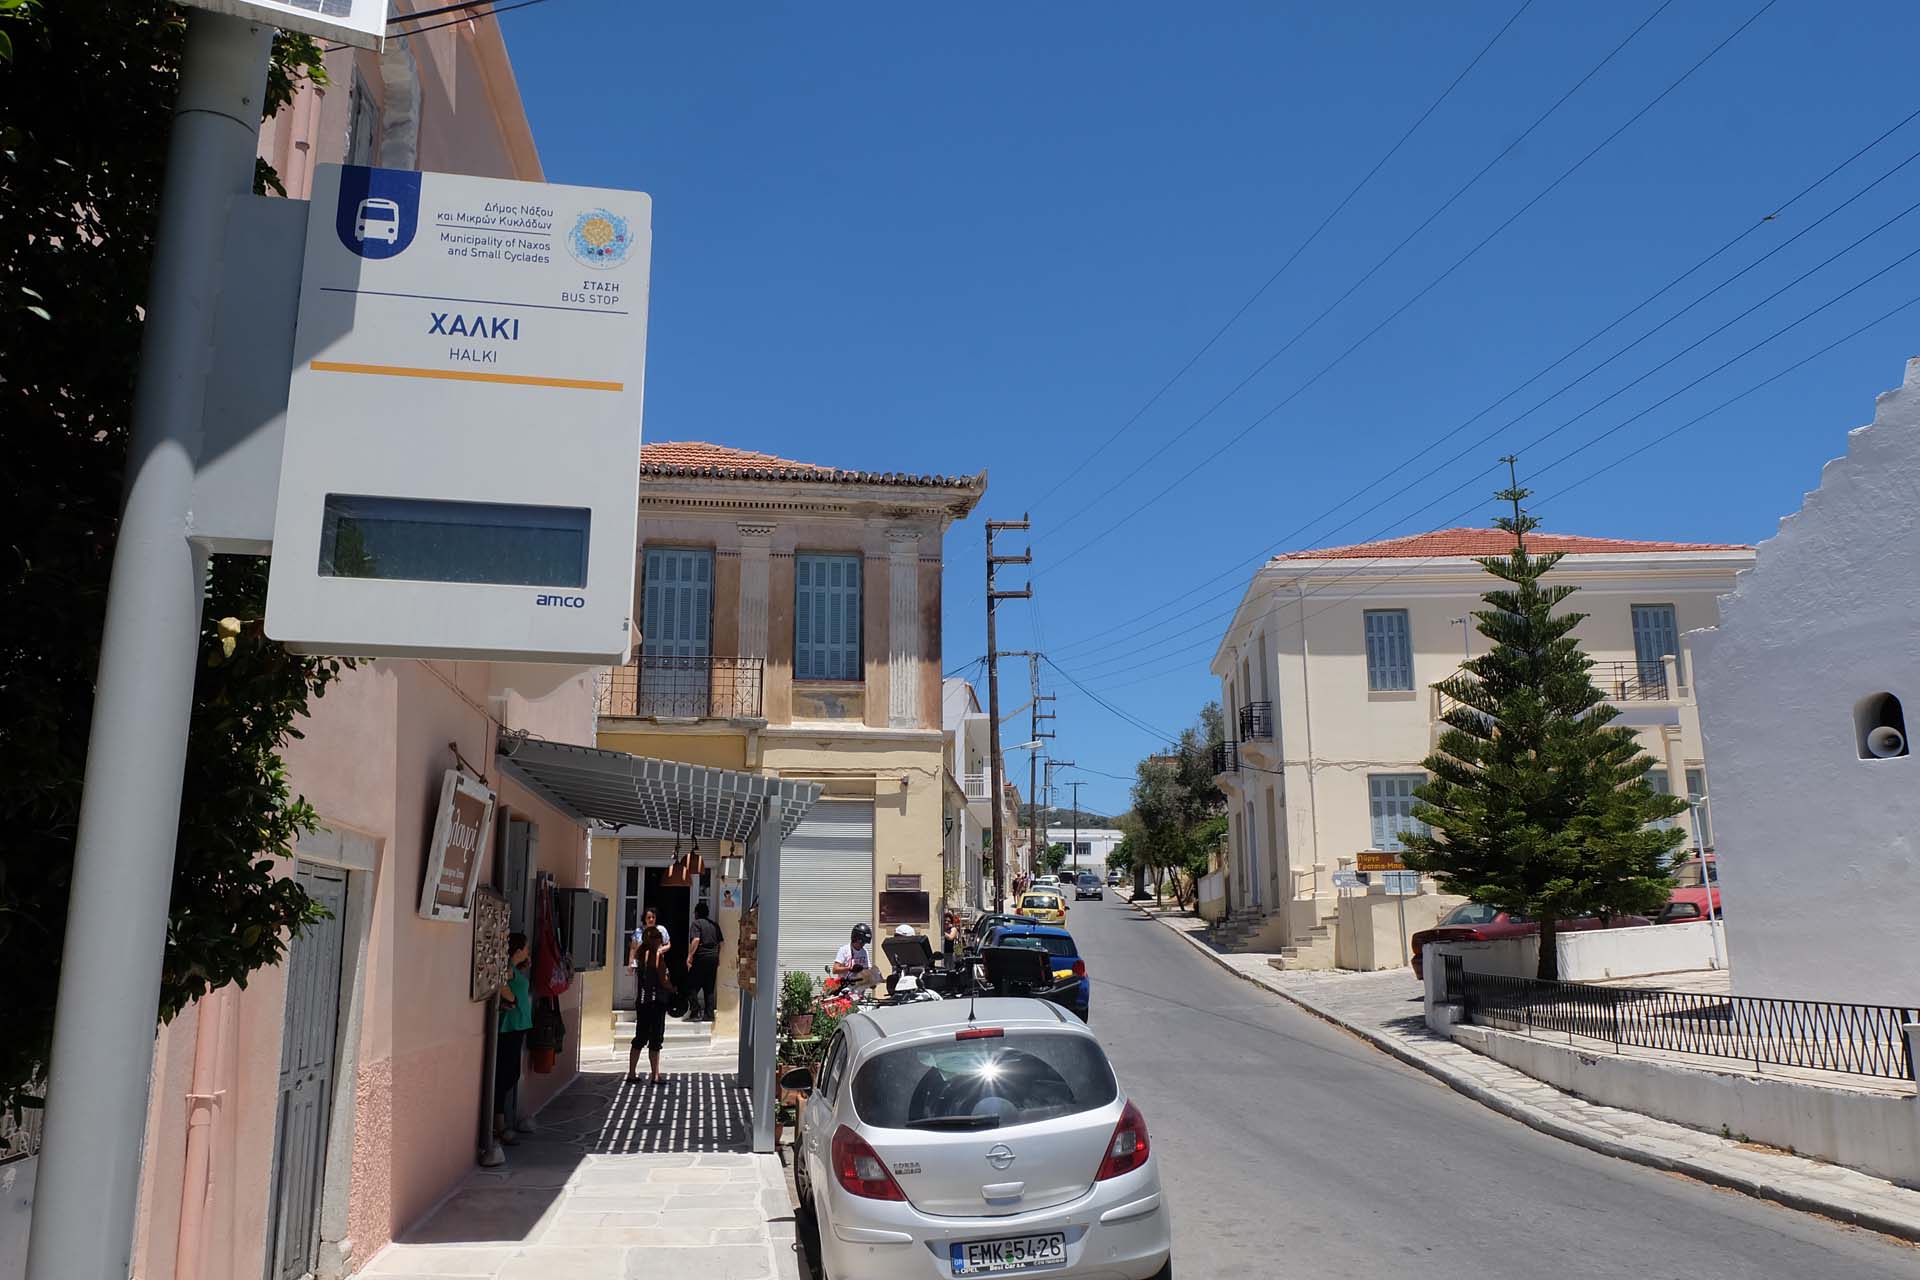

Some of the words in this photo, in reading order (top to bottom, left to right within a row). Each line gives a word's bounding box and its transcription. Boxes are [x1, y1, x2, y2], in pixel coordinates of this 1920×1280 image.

[484, 202, 518, 215] Δήμος
[520, 205, 554, 218] Νάξου
[437, 212, 453, 221] και
[457, 212, 497, 225] Μικρών
[500, 216, 552, 230] Κυκλάδων
[440, 232, 503, 249] Municipality
[505, 238, 516, 248] of
[519, 239, 551, 251] Naxos
[448, 247, 468, 257] and
[471, 248, 501, 259] Small
[504, 250, 550, 264] Cyclades
[583, 280, 620, 293] ΣΤΑΣΗ
[561, 291, 586, 303] BUS
[589, 294, 620, 305] STOP
[428, 311, 520, 341] ΧΑΛΚΙ
[449, 347, 498, 363] HALKI
[536, 594, 585, 609] amco
